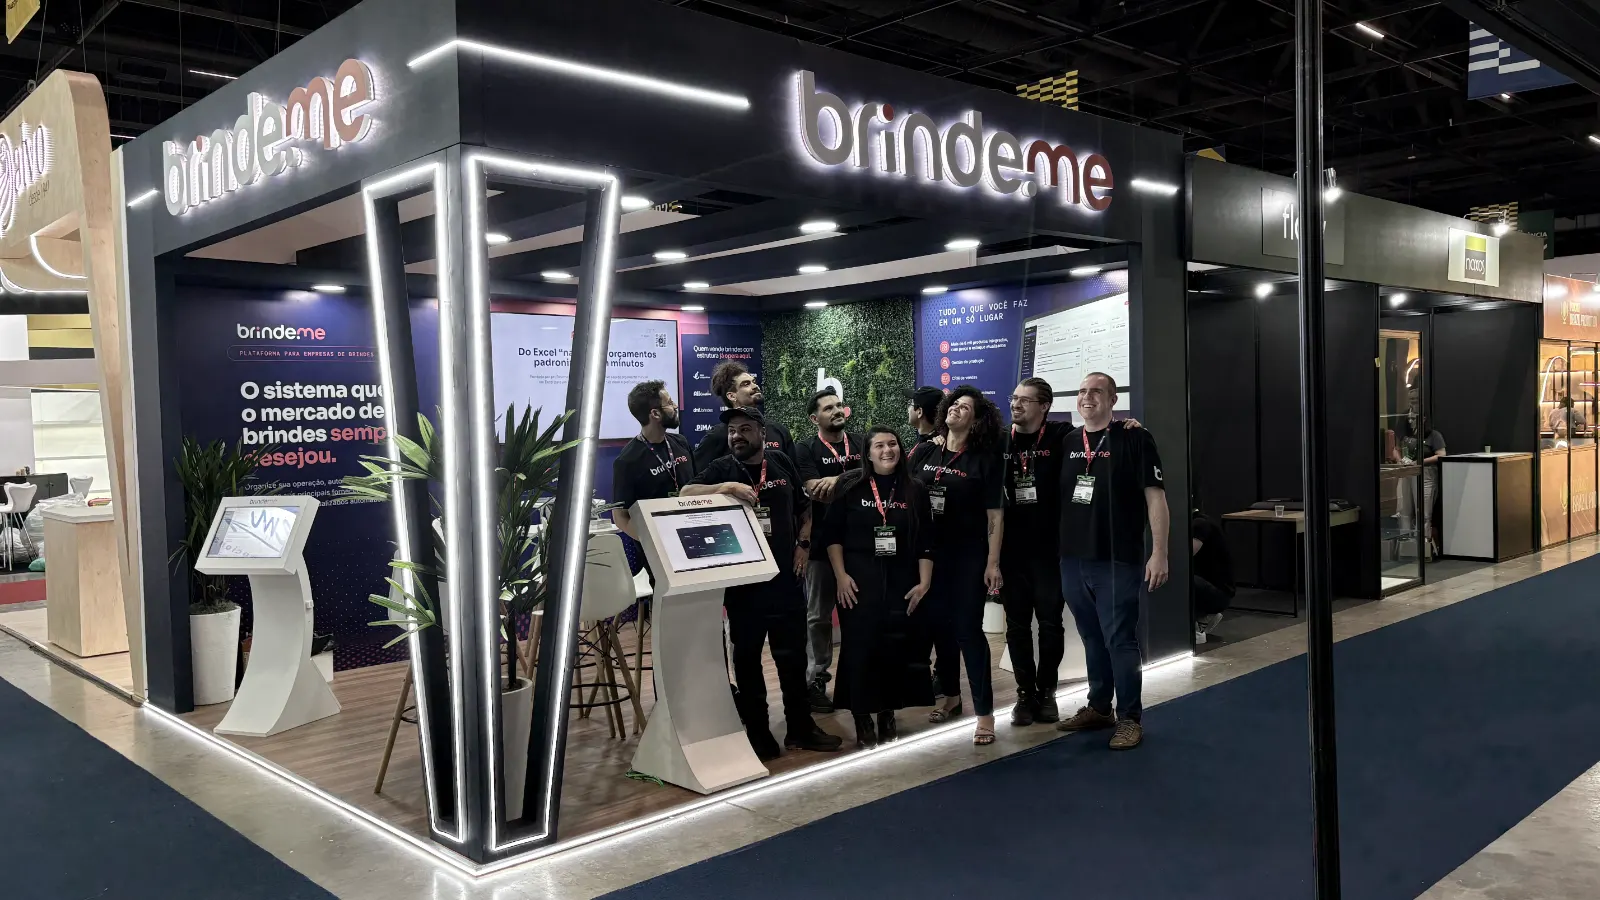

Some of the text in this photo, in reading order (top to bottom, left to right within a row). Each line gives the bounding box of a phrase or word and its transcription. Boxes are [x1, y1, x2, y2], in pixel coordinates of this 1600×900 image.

[798, 70, 1113, 212] brinde.me
[939, 308, 957, 316] TUDO
[970, 304, 984, 315] QUE
[989, 300, 1008, 311] VOCÊ
[1013, 299, 1028, 308] FAZ
[939, 313, 1004, 326] EM UM SÓ LUGAR
[518, 347, 532, 357] Do
[533, 347, 557, 357] Excel
[609, 351, 657, 360] orçamentos
[534, 358, 572, 368] padroni
[610, 360, 645, 368] minutos
[240, 381, 260, 400] O
[263, 380, 348, 399] sistema
[241, 402, 384, 422] o mercado de
[242, 425, 387, 445] brindes semp
[292, 478, 327, 488] operação,
